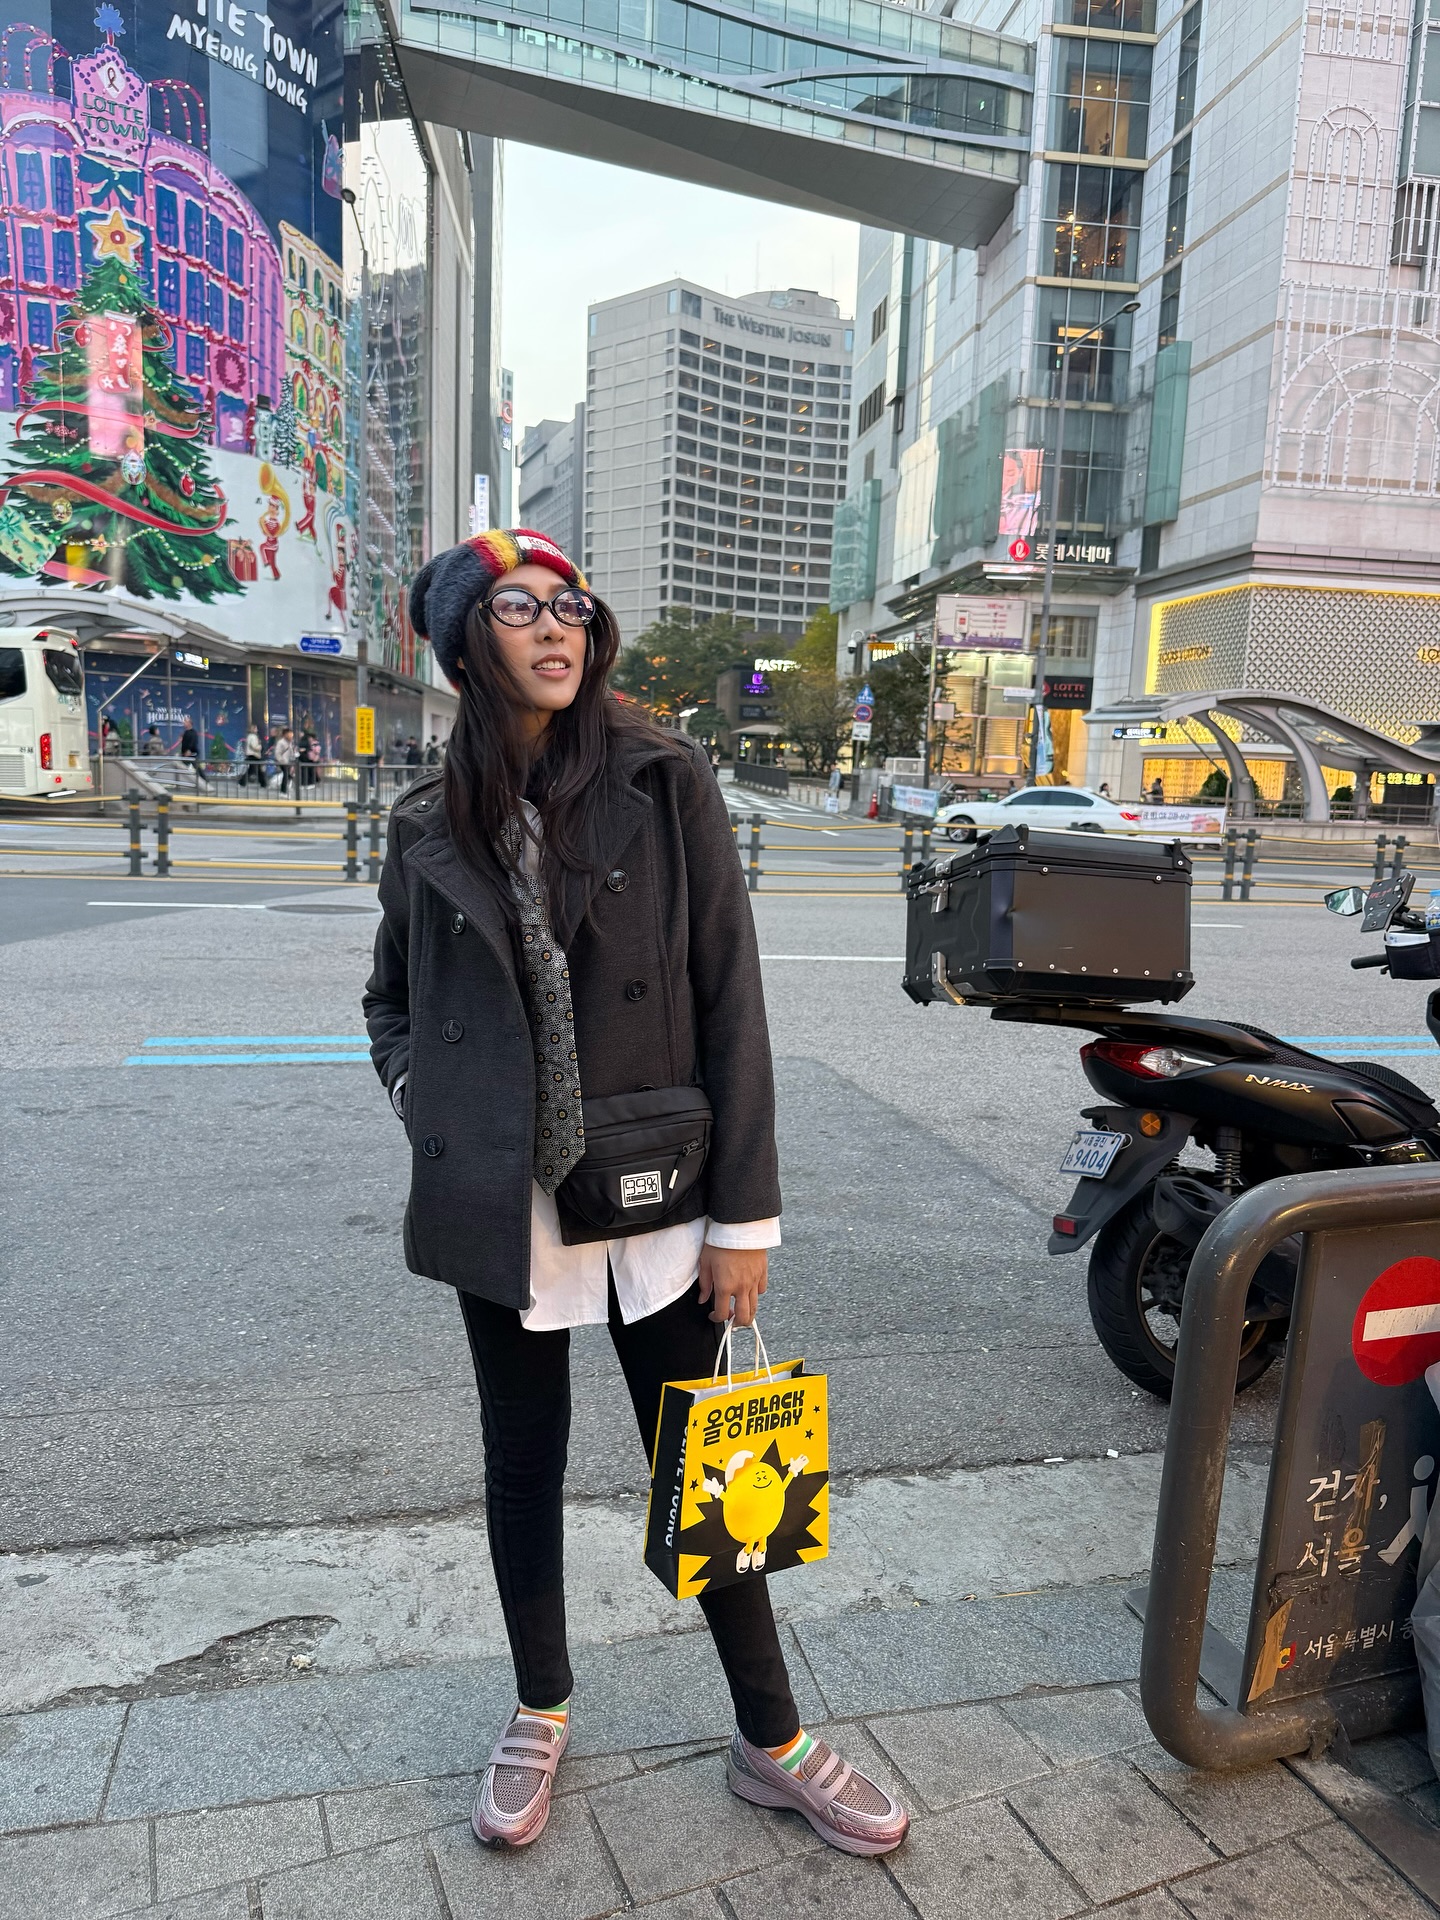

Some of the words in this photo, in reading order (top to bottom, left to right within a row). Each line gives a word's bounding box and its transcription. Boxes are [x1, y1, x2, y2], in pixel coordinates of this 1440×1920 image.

[166, 14, 259, 80] MYEONG
[265, 60, 308, 114] DONG
[254, 12, 318, 88] TOWN
[83, 92, 144, 125] LOTTE
[80, 112, 146, 142] TOWN
[713, 306, 736, 327] THE
[737, 313, 785, 339] WESTIN
[788, 326, 831, 348] JOSUN
[1035, 543, 1112, 564] 롯데시네마
[1245, 1074, 1315, 1093] NMAX
[1073, 1149, 1109, 1171] 9404
[625, 1177, 658, 1196] 99%
[747, 1390, 805, 1417] BLACK
[703, 1402, 744, 1447] 올영
[745, 1408, 803, 1436] FRIDAY
[1306, 1470, 1388, 1522] 걷자,
[1296, 1531, 1371, 1577] 서울
